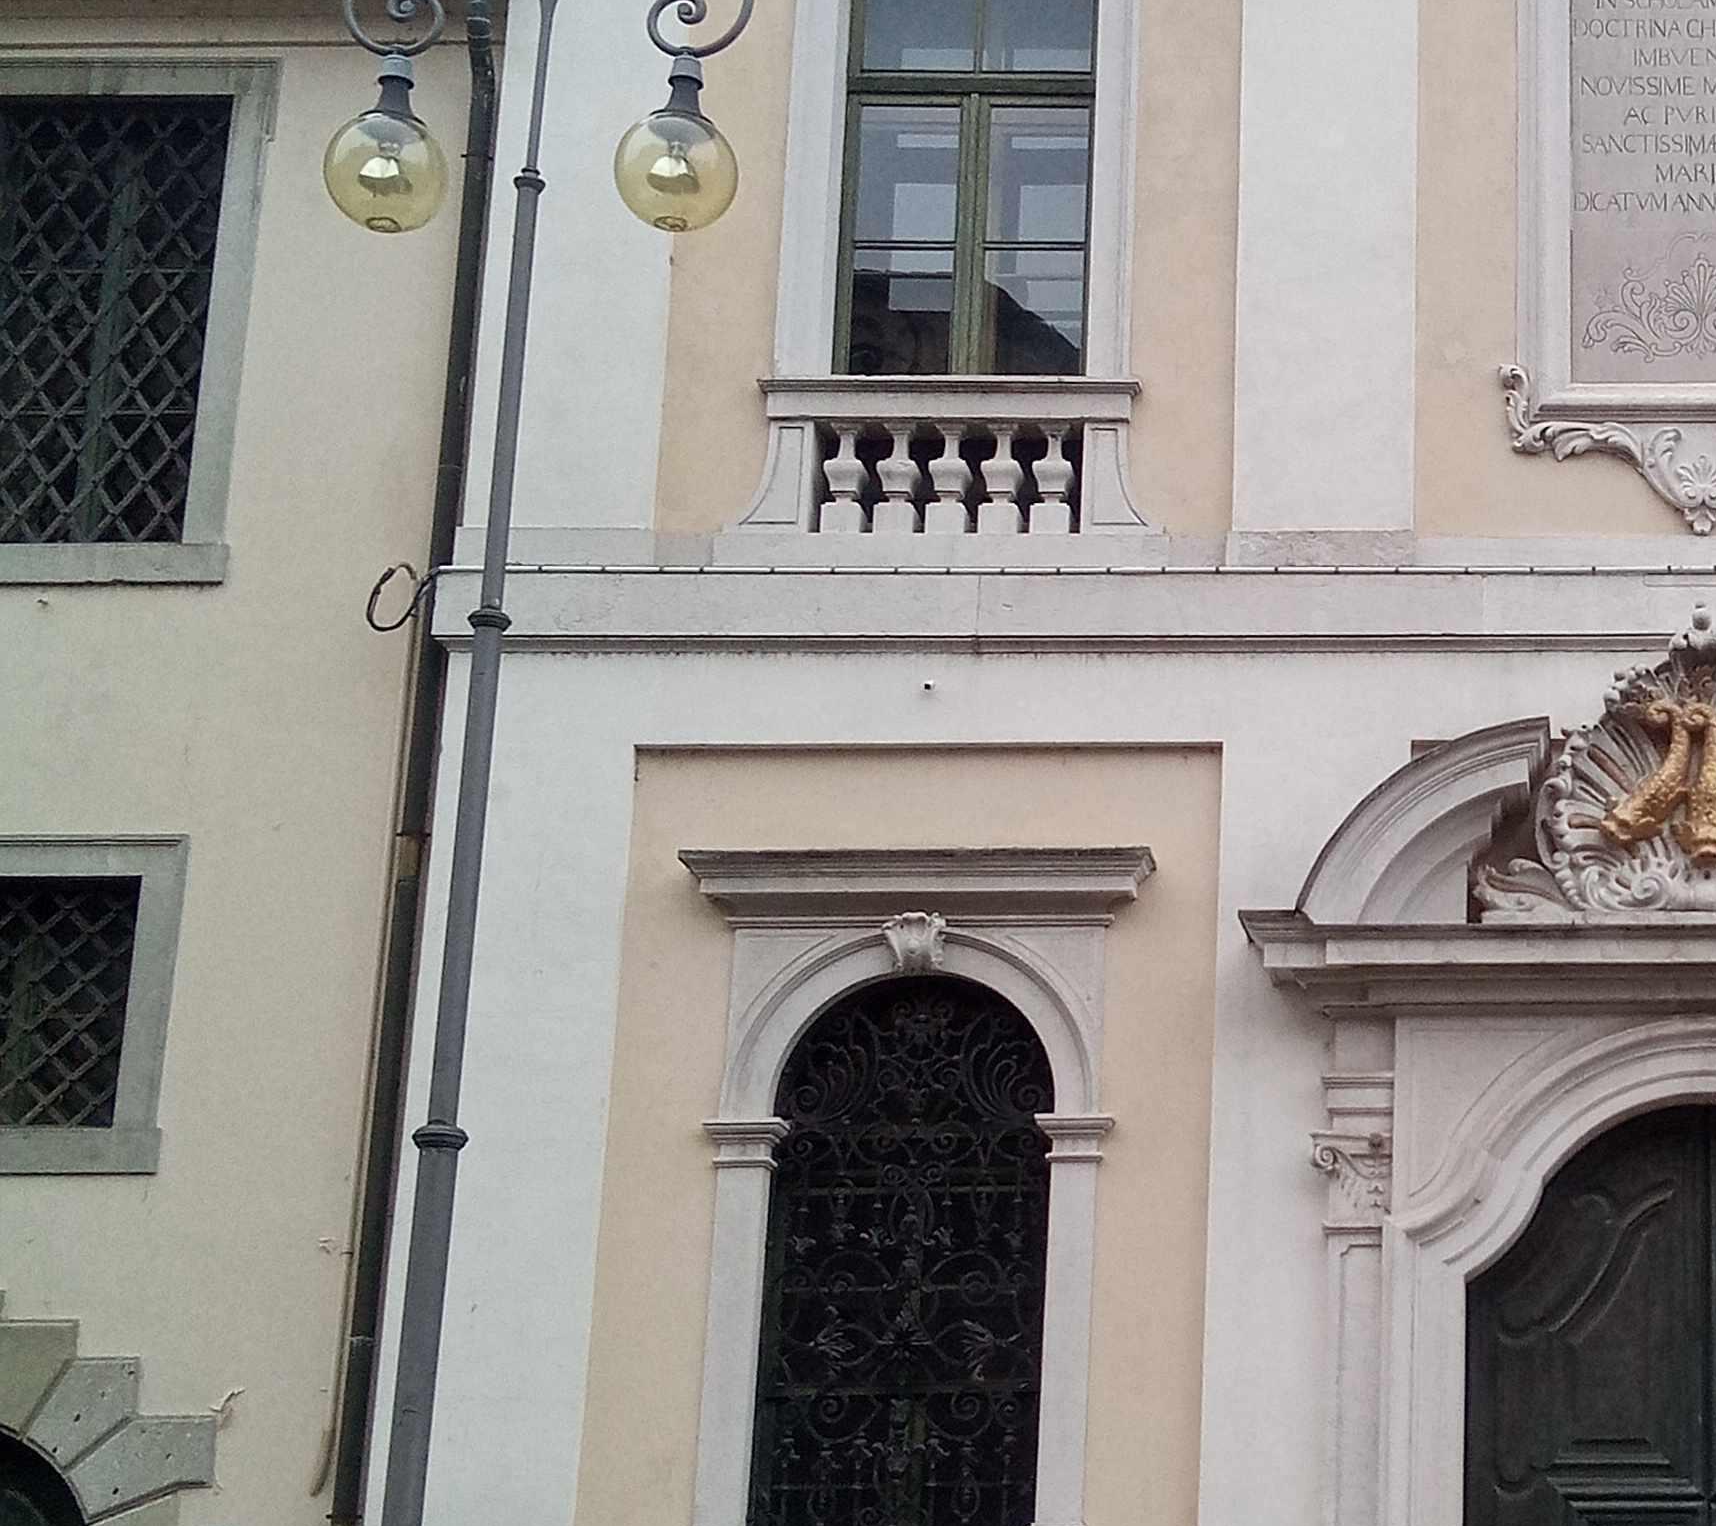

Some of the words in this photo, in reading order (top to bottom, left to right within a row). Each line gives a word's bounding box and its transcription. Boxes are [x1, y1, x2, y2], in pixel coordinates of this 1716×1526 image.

[1573, 18, 1682, 39] DOCTRINA
[1580, 75, 1696, 96] NOVISSIME
[1623, 106, 1655, 126] AC
[1573, 191, 1667, 212] DICATVM
